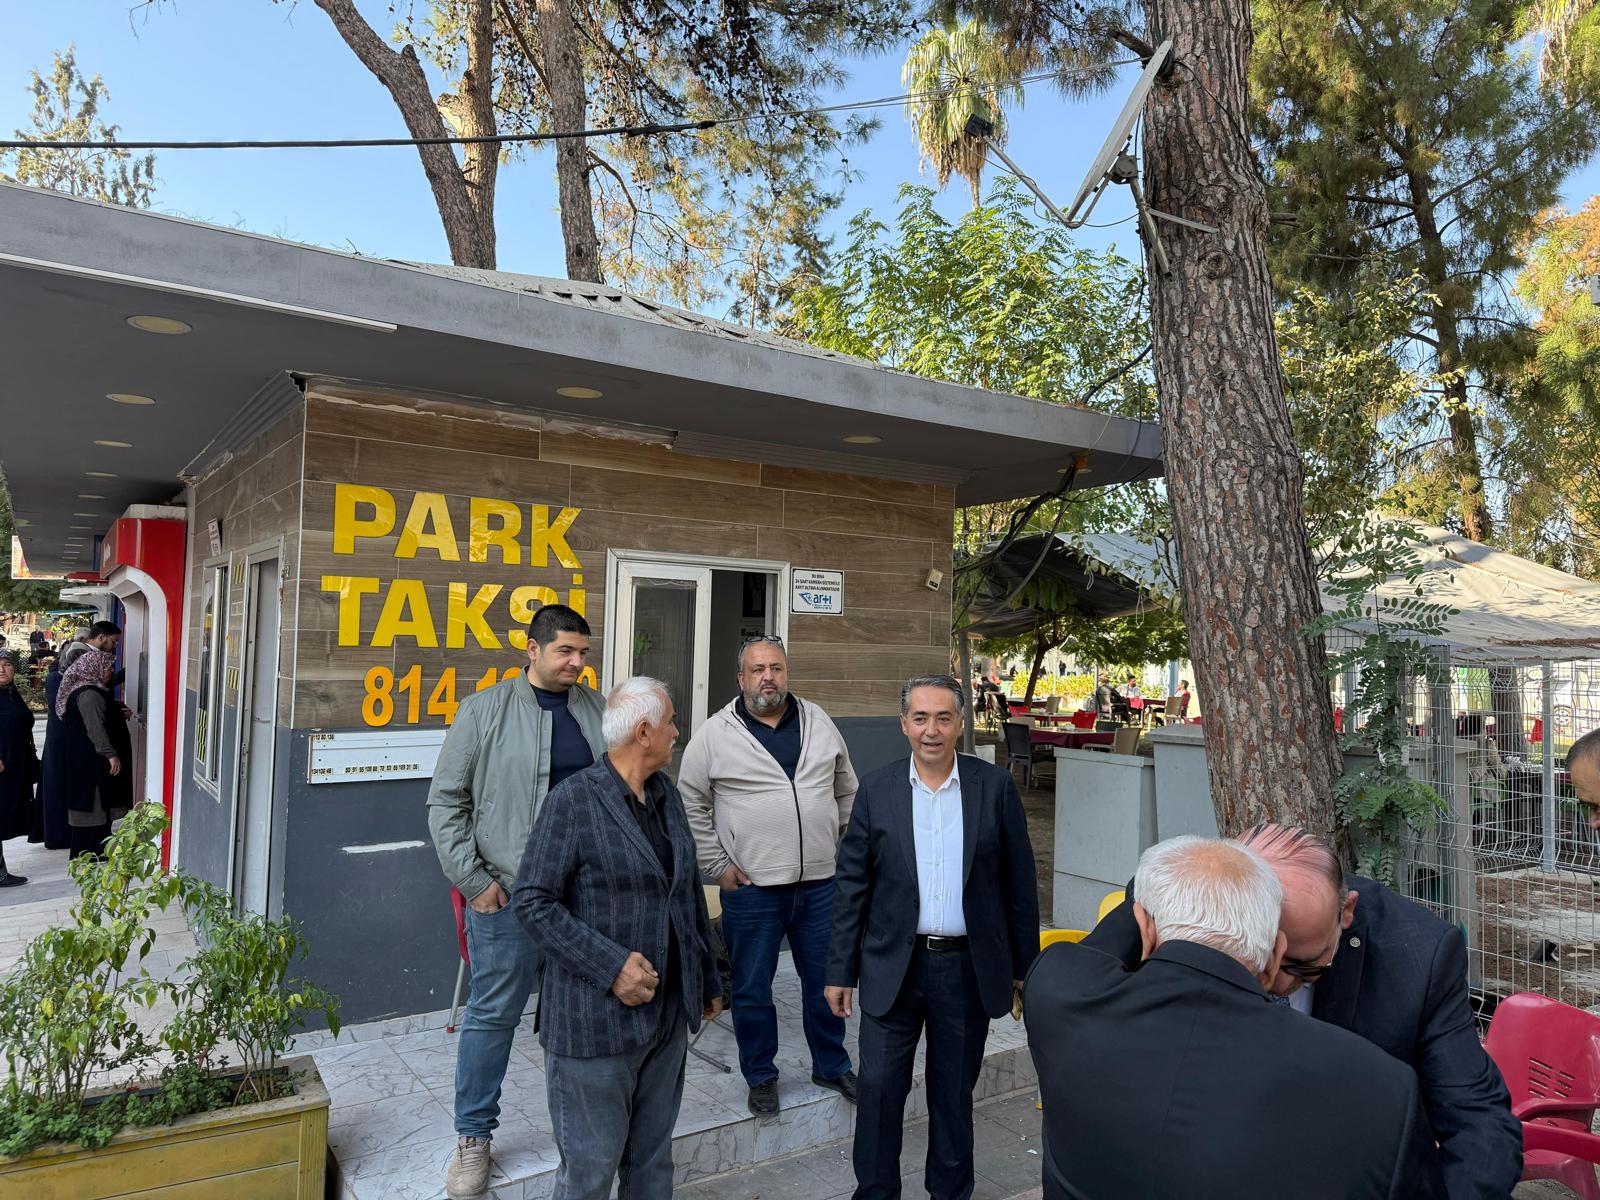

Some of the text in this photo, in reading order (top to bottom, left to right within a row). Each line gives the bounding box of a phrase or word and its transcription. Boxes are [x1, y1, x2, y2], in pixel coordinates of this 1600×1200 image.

[333, 482, 583, 569] PARK
[321, 574, 587, 652] TAKSİ
[362, 664, 460, 727] 814
